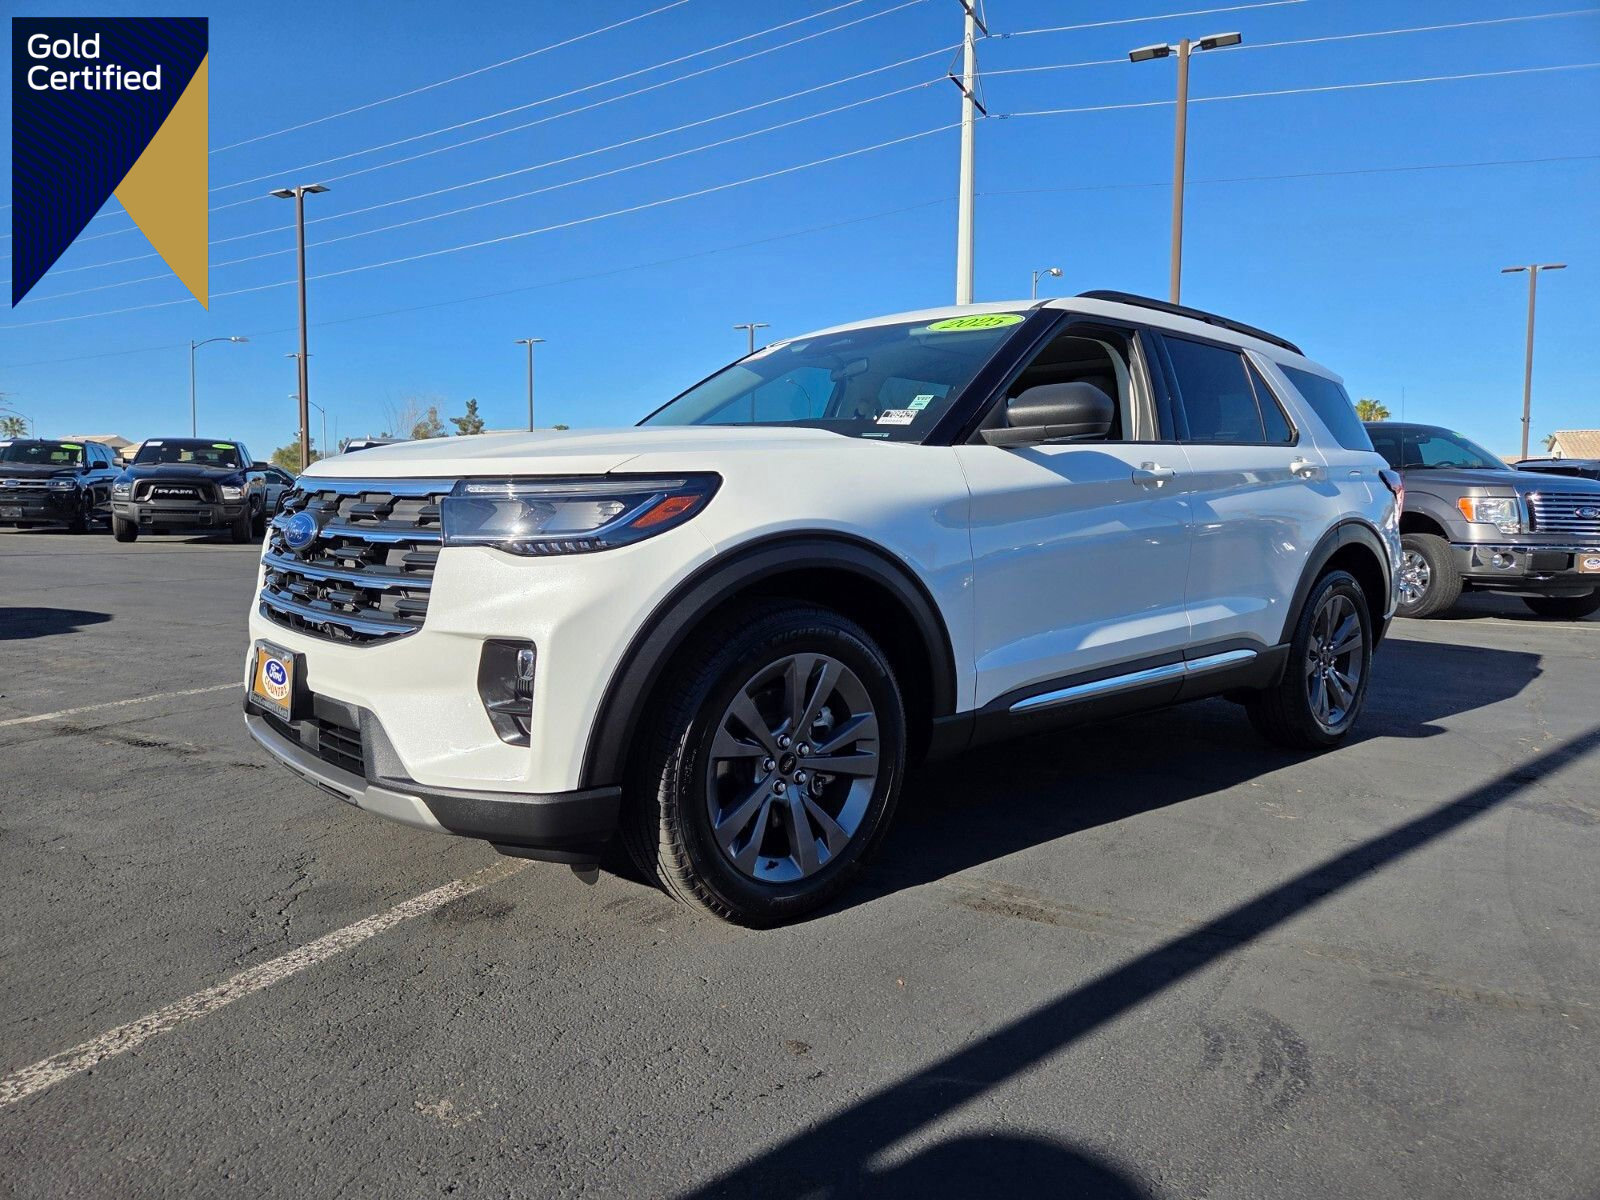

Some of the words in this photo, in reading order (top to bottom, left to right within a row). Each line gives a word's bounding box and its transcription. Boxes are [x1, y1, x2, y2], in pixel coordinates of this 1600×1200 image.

[939, 316, 1013, 329] 2025
[288, 518, 307, 541] Ford
[268, 662, 284, 683] Ford
[264, 675, 288, 697] COUNTRY
